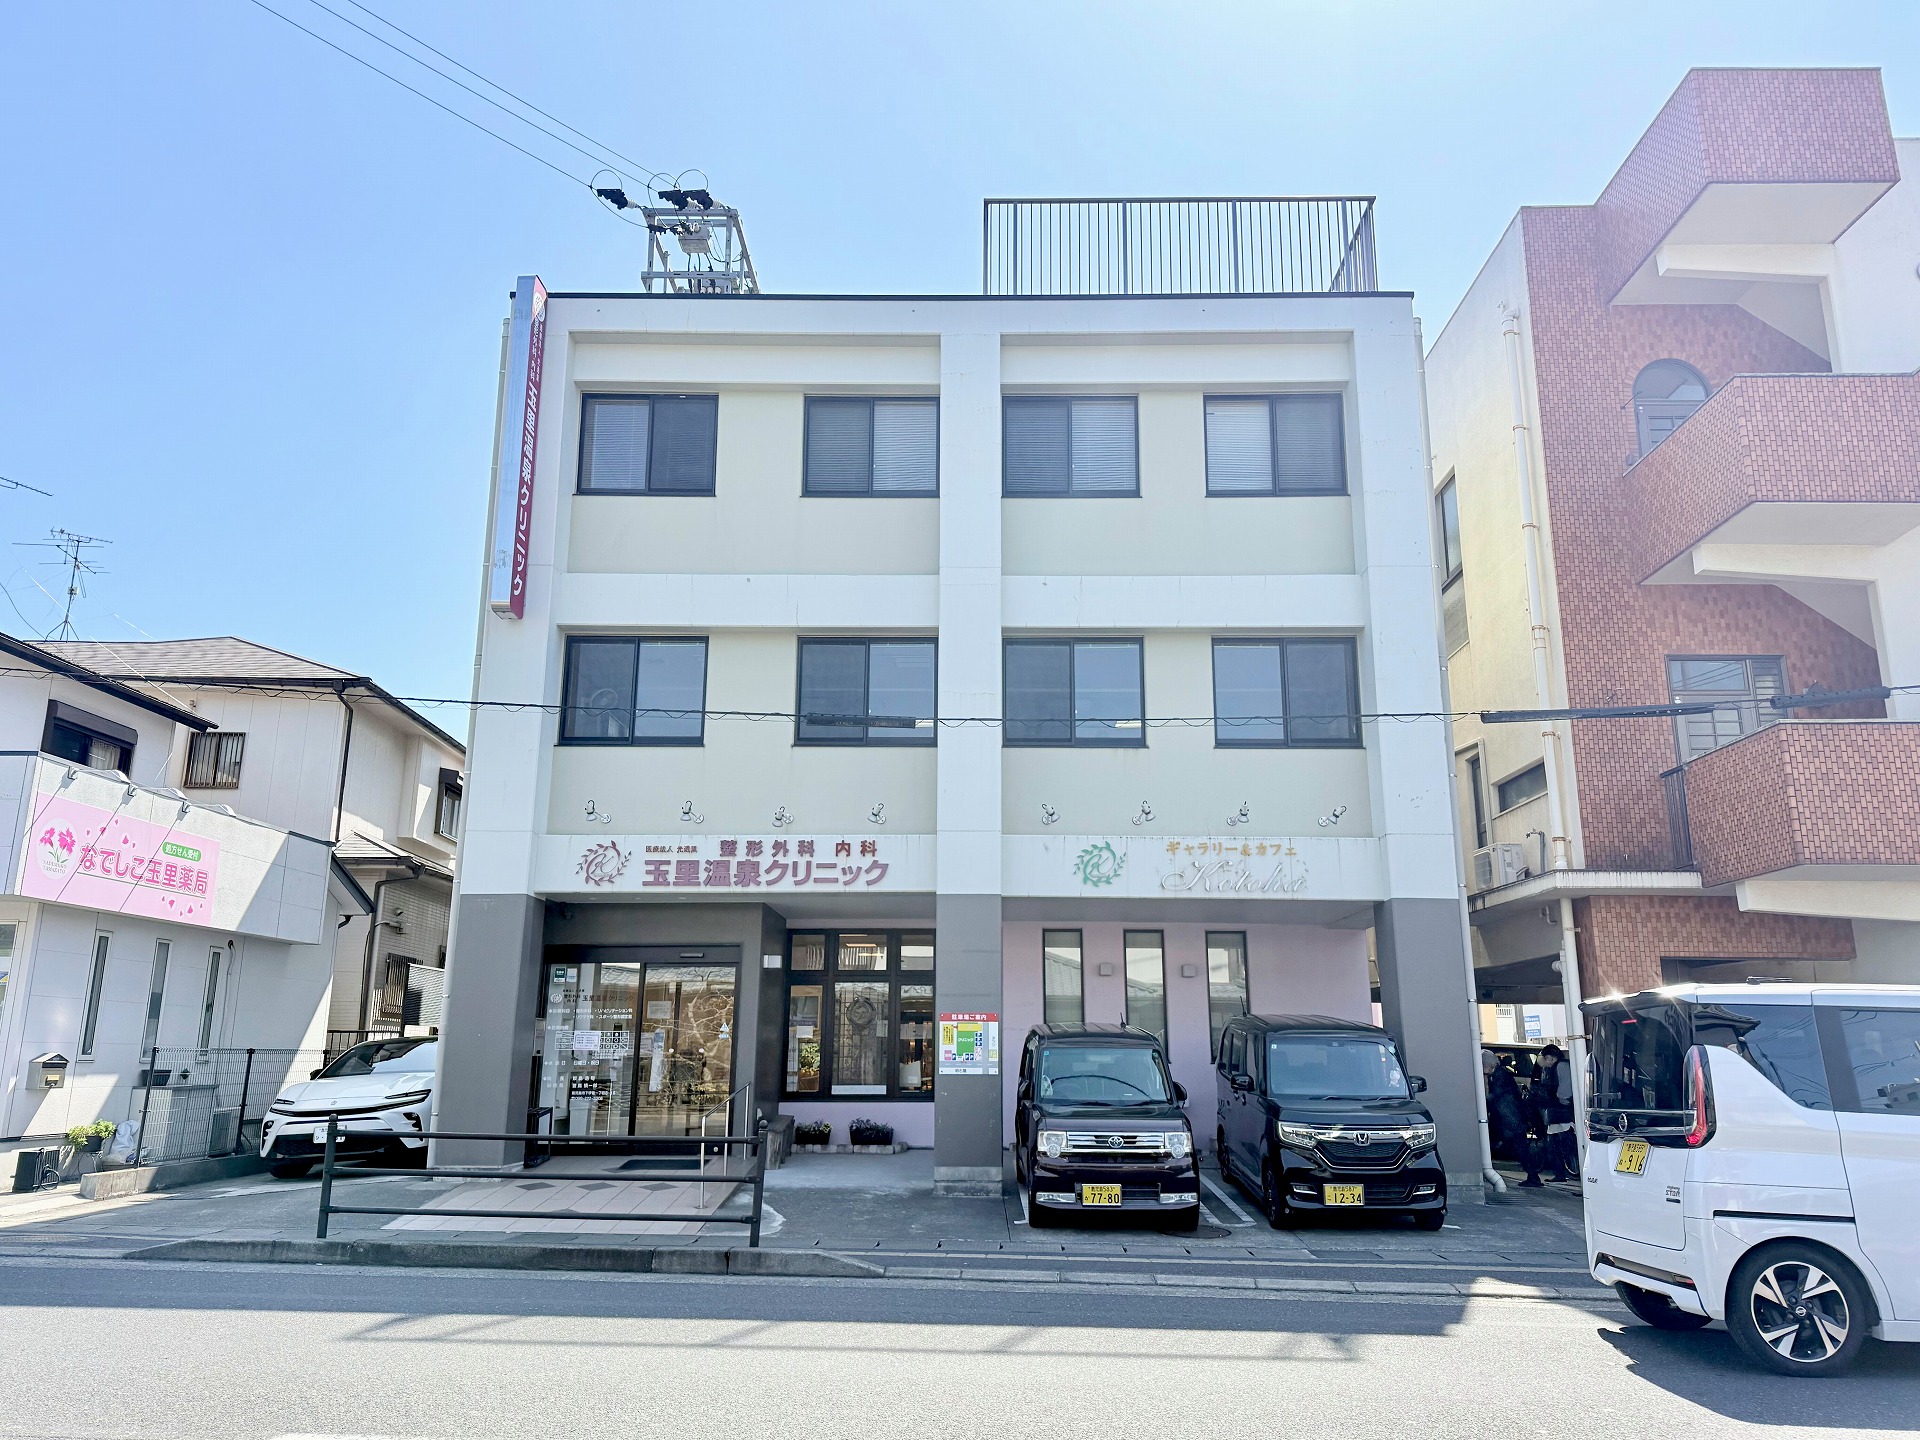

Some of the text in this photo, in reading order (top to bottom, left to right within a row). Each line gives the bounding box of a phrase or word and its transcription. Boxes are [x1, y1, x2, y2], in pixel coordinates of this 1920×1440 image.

[513, 380, 539, 596] 玉里温泉クリニック
[719, 839, 816, 858] 整形外科
[835, 839, 878, 858] 内科
[80, 844, 207, 894] なでしこ玉里薬局
[641, 858, 890, 888] 玉里温泉クリニック
[1091, 1193, 1120, 1204] 77-80
[1334, 1192, 1362, 1204] 12-34
